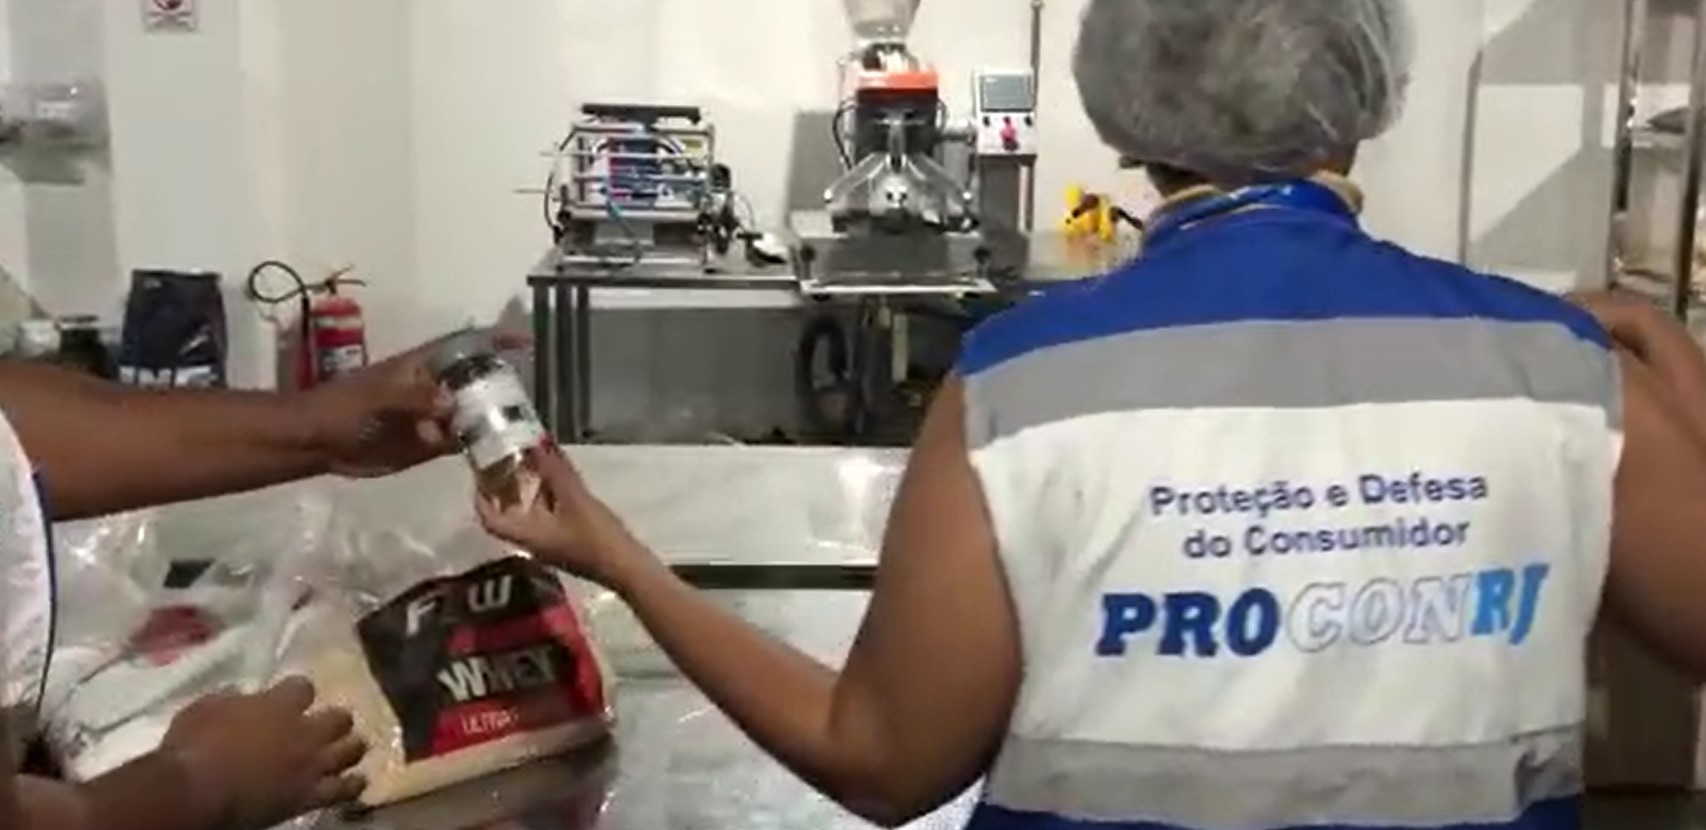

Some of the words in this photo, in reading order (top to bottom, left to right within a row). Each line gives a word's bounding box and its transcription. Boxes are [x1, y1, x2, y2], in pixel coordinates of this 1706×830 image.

[1151, 483, 1314, 518] Proteção
[1326, 484, 1349, 507] e
[1359, 472, 1488, 505] Defesa
[1183, 530, 1229, 558] do
[1245, 517, 1471, 555] Consumidor
